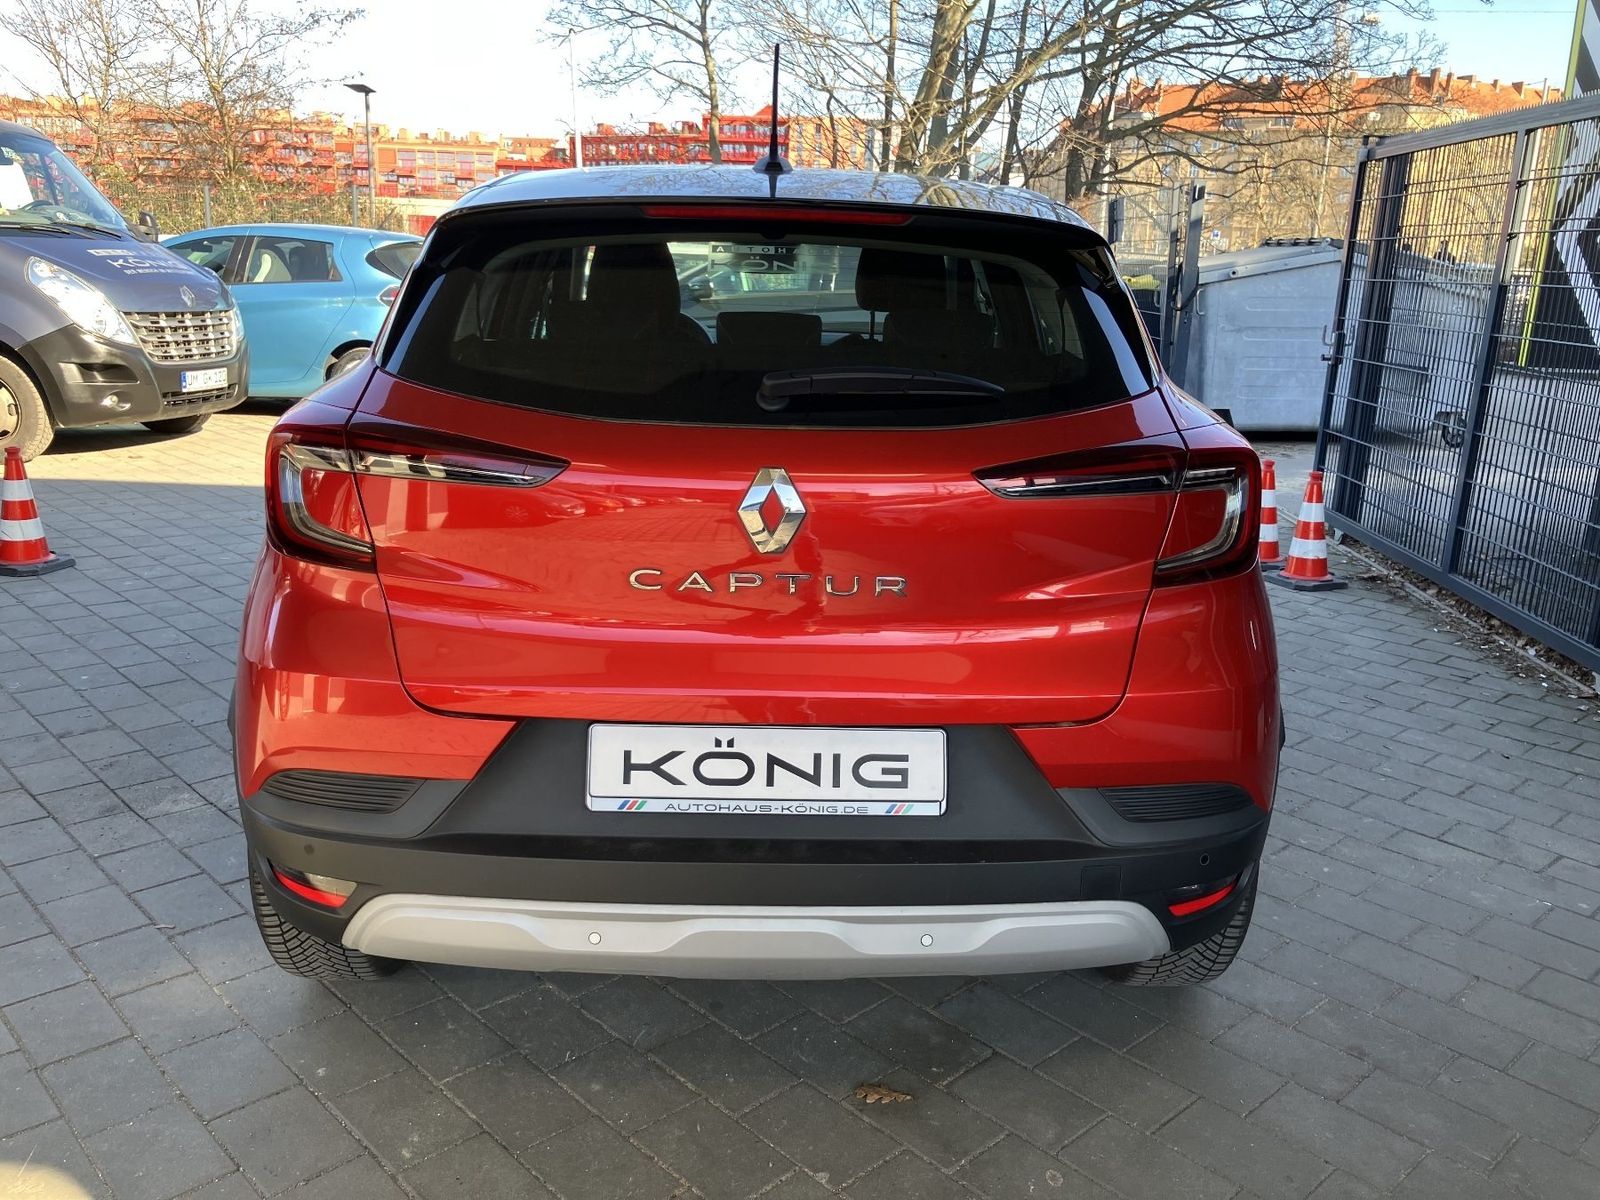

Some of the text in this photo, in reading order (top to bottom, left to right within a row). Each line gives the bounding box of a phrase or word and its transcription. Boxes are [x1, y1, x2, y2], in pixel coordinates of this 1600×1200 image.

[628, 569, 908, 597] CAPTUR
[622, 736, 910, 789] KÖNIG
[664, 802, 869, 815] AUTOHAUS-KÖNIG.DE
